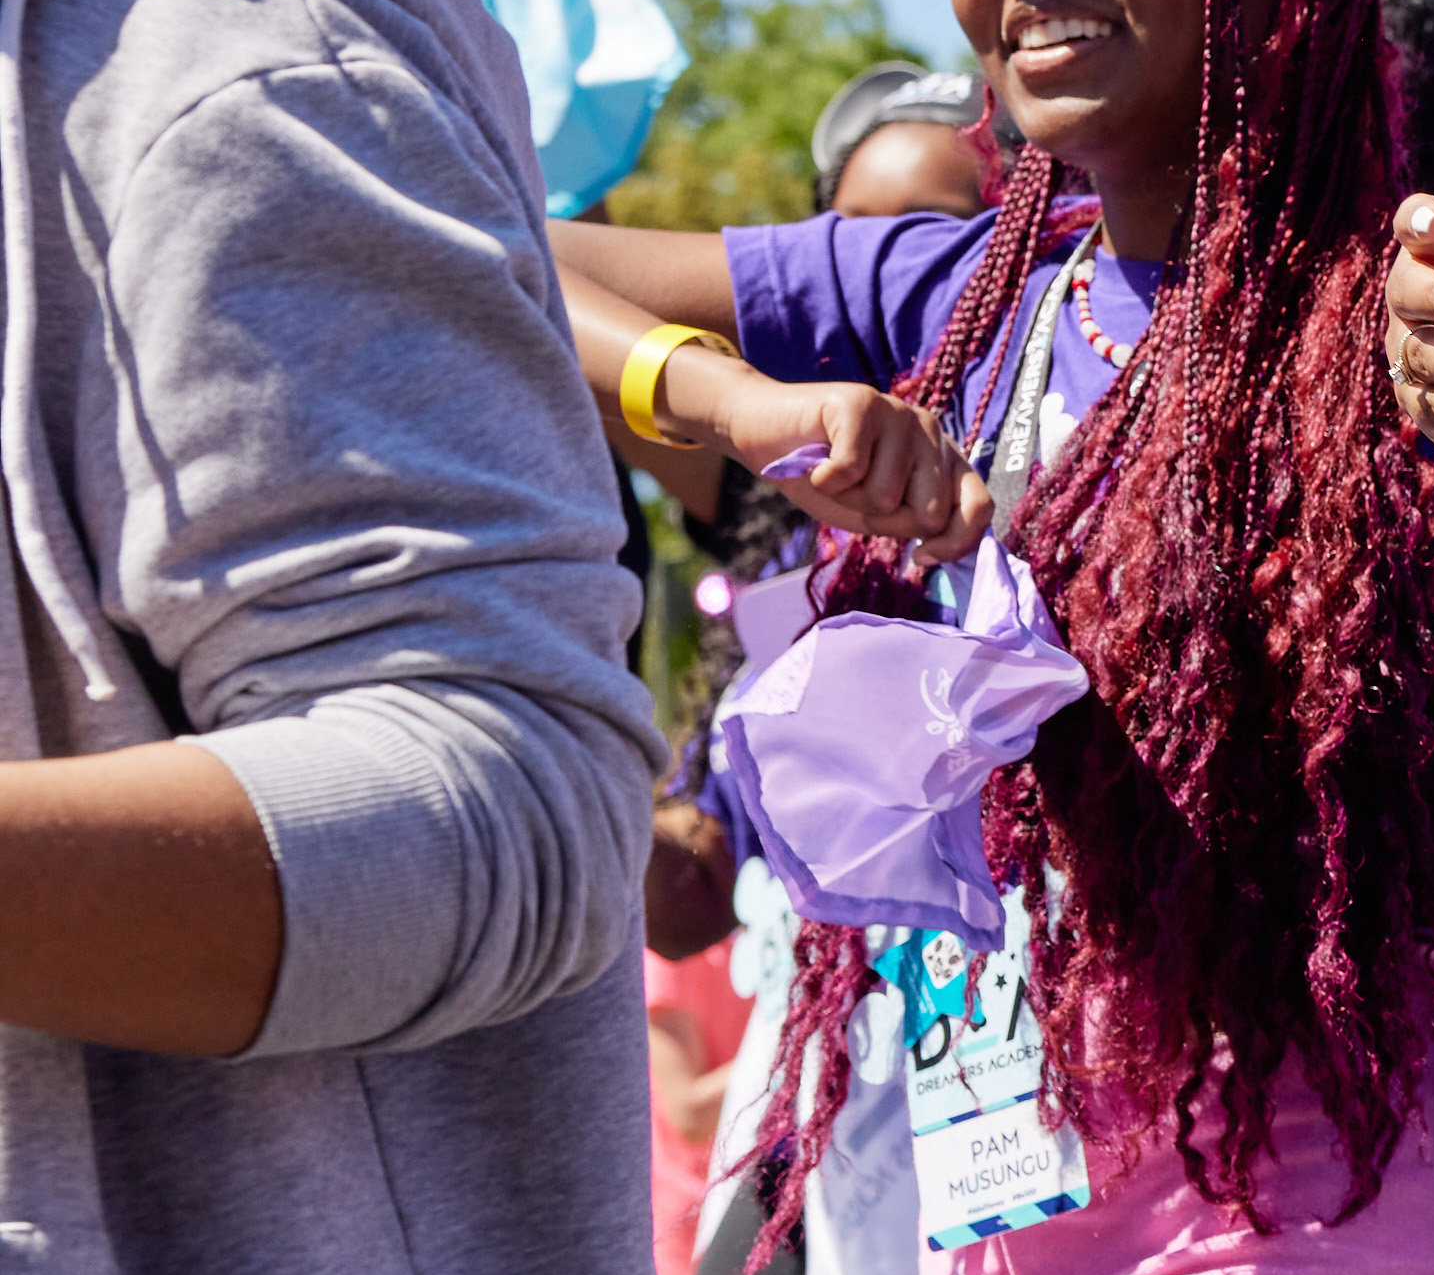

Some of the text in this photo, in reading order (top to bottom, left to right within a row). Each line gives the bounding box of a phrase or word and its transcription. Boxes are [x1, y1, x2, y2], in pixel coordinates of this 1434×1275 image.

[1005, 349, 1046, 472] DREAMERS
[988, 1042, 1044, 1076] ACADEM
[970, 1129, 1022, 1165] PAM
[948, 1150, 1051, 1202] MUSUNGU
